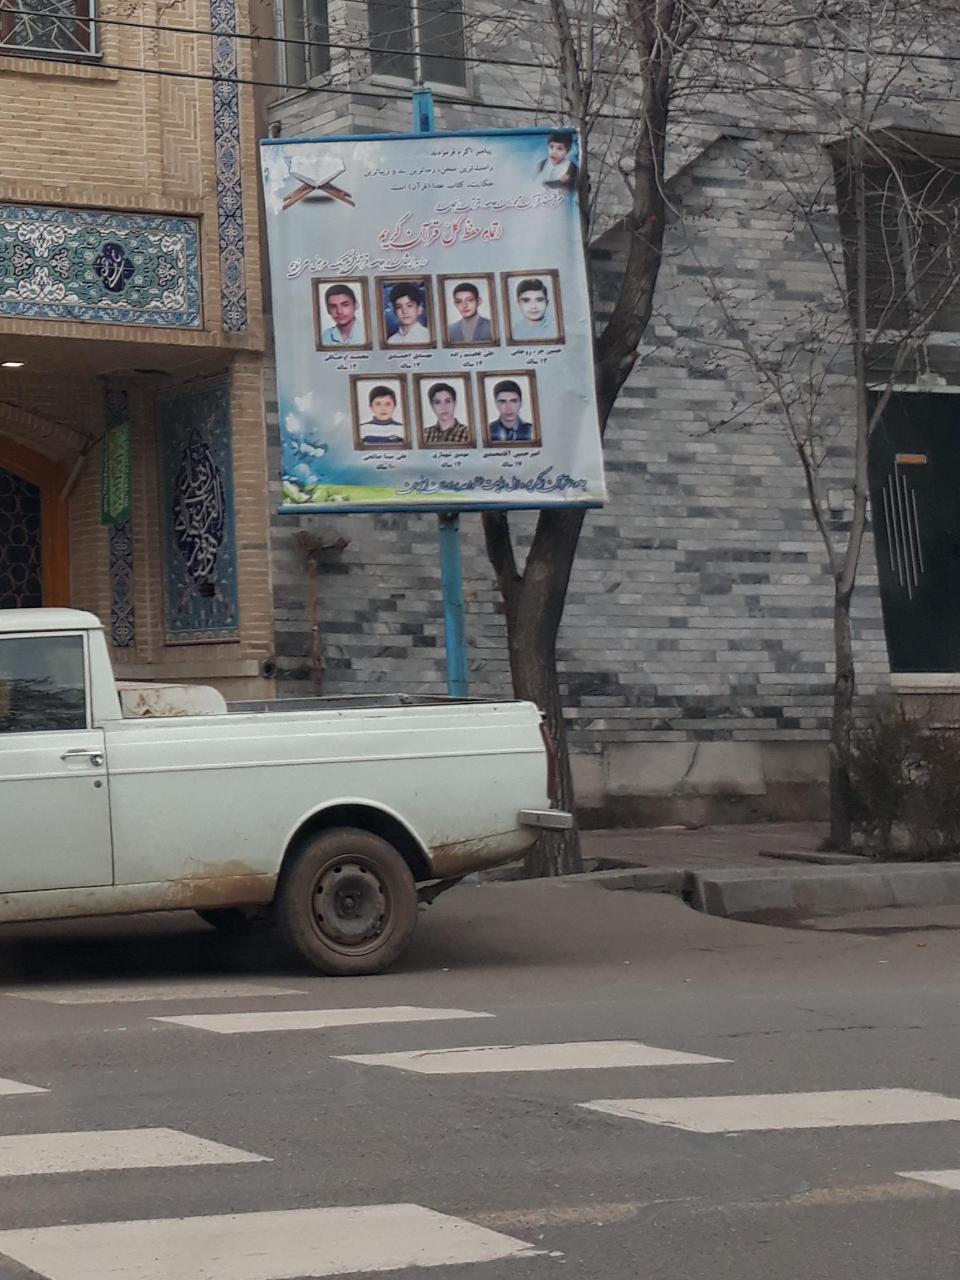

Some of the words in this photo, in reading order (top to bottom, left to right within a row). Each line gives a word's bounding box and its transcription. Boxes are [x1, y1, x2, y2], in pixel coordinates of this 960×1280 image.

[378, 212, 412, 249] کریم
[390, 220, 440, 249] قرآن
[442, 214, 467, 247] کل
[463, 220, 481, 240] حفظ
